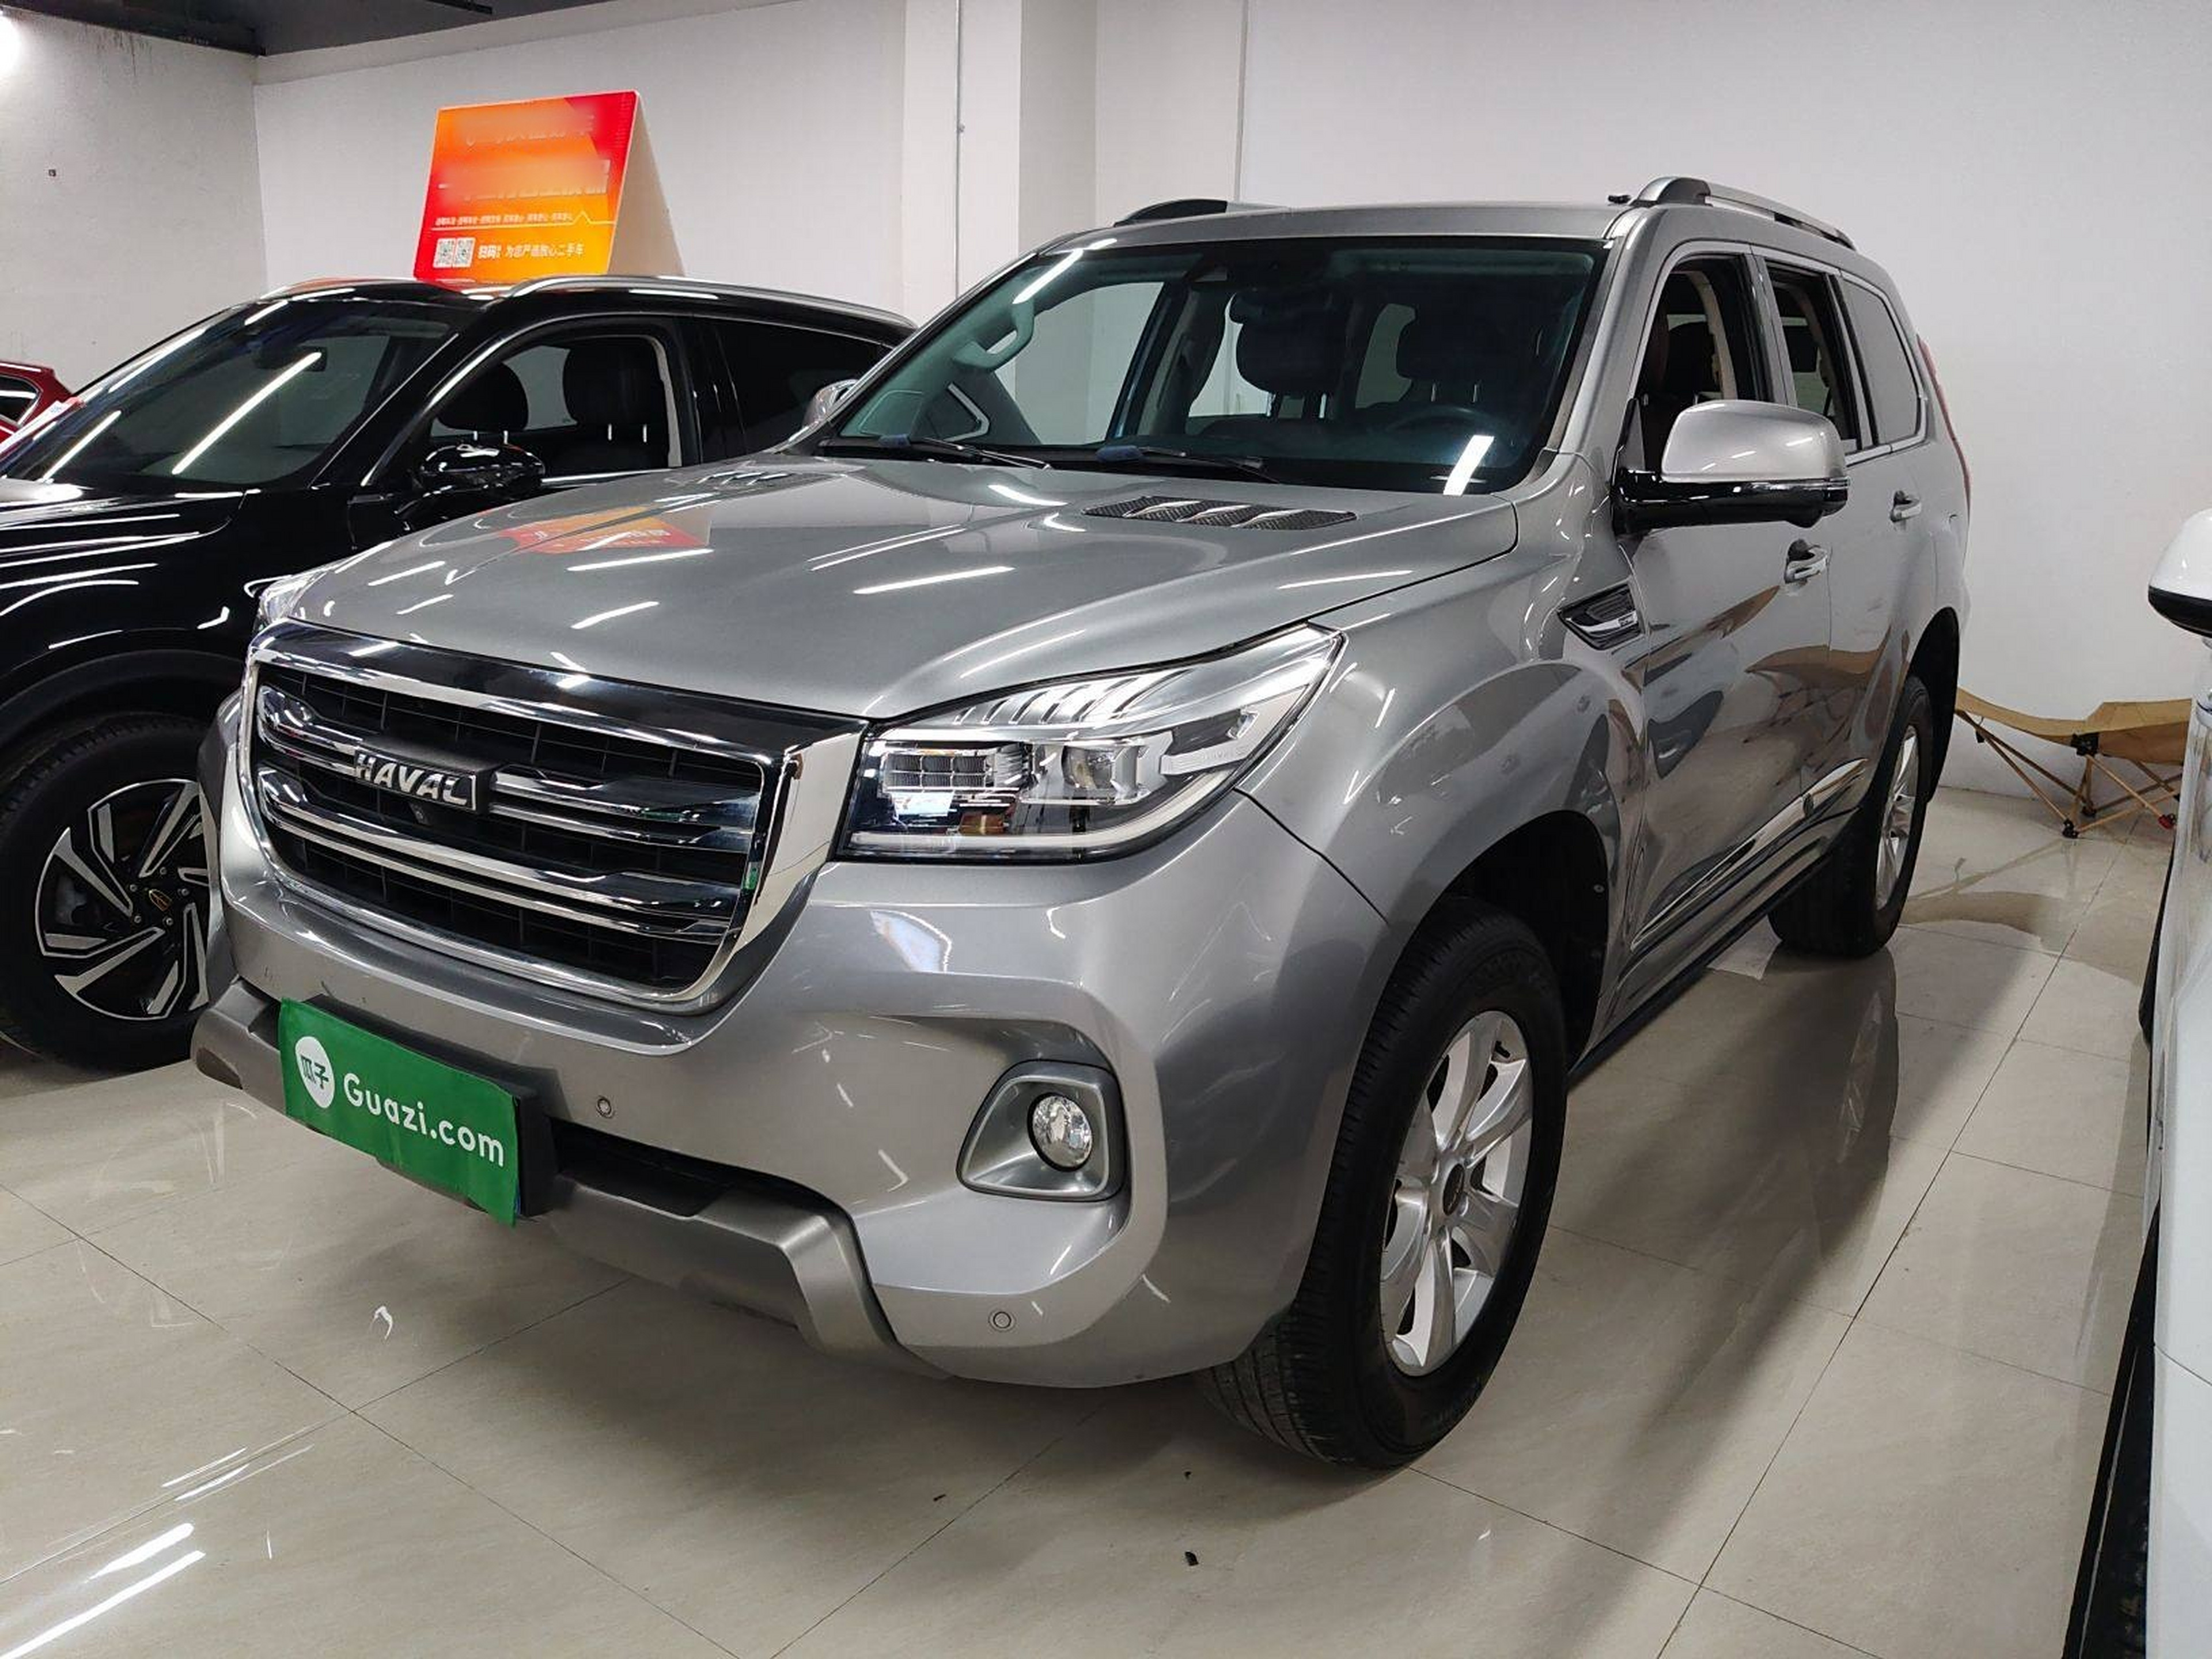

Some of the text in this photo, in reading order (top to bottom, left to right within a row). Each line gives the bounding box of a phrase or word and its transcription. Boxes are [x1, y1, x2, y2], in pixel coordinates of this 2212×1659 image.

[355, 753, 467, 806] HAVAL
[300, 1054, 329, 1090] 瓜子
[343, 1073, 504, 1166] Guazi.com
